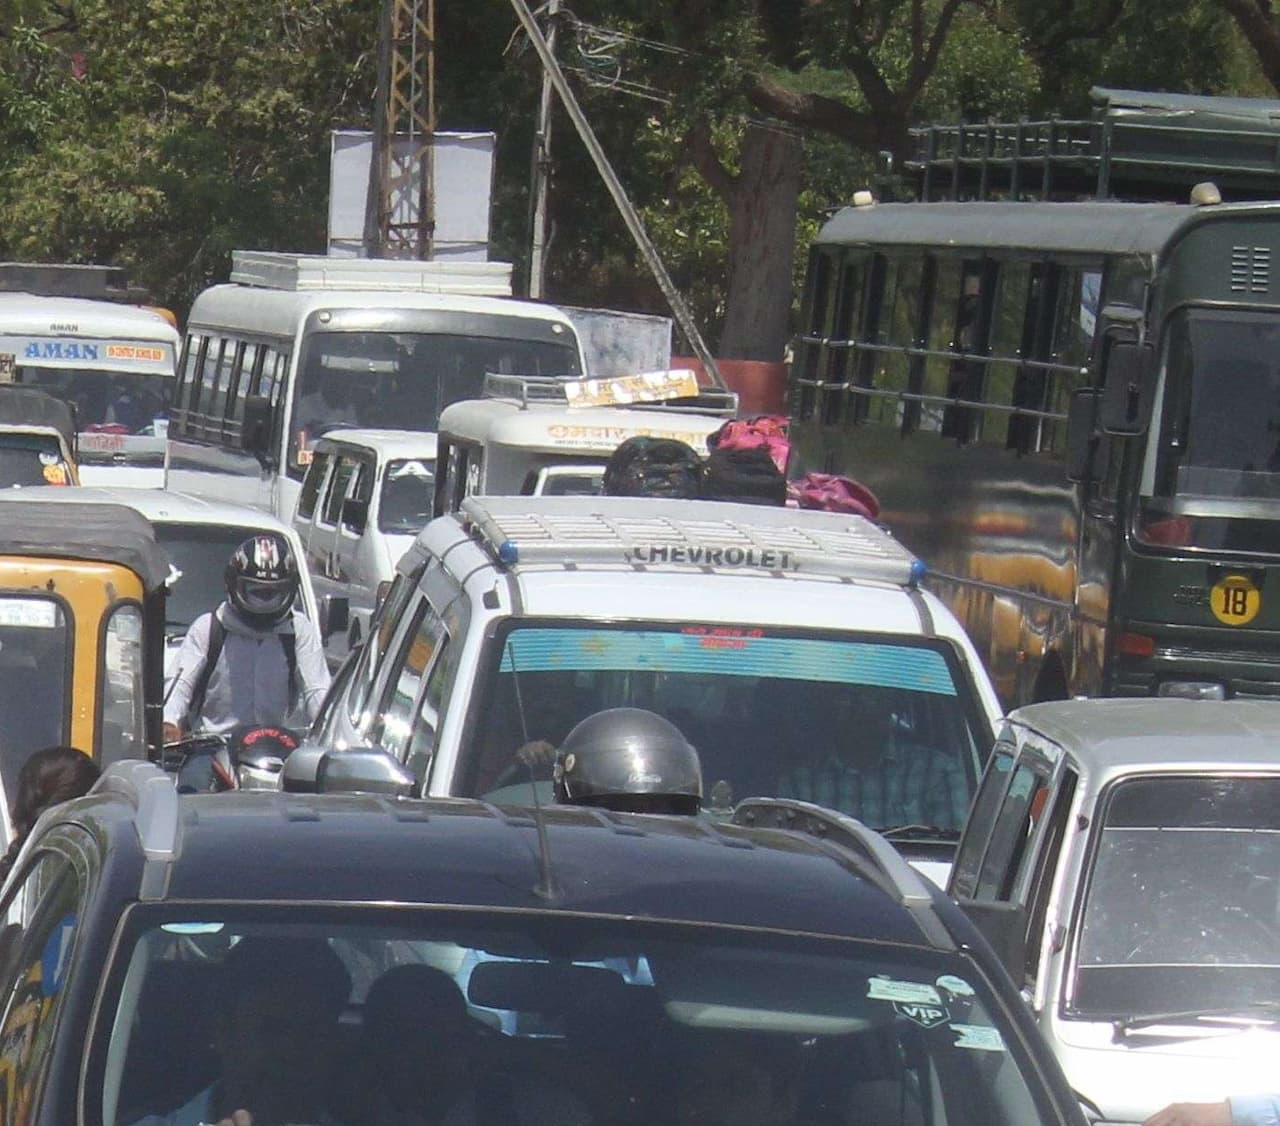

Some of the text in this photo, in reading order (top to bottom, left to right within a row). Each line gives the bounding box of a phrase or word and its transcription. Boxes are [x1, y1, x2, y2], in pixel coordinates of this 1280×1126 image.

[49, 323, 79, 333] AMAN
[25, 341, 98, 360] AMAN
[633, 547, 791, 569] CHEVROLET
[1222, 586, 1247, 616] 18
[901, 1006, 942, 1020] VIP
